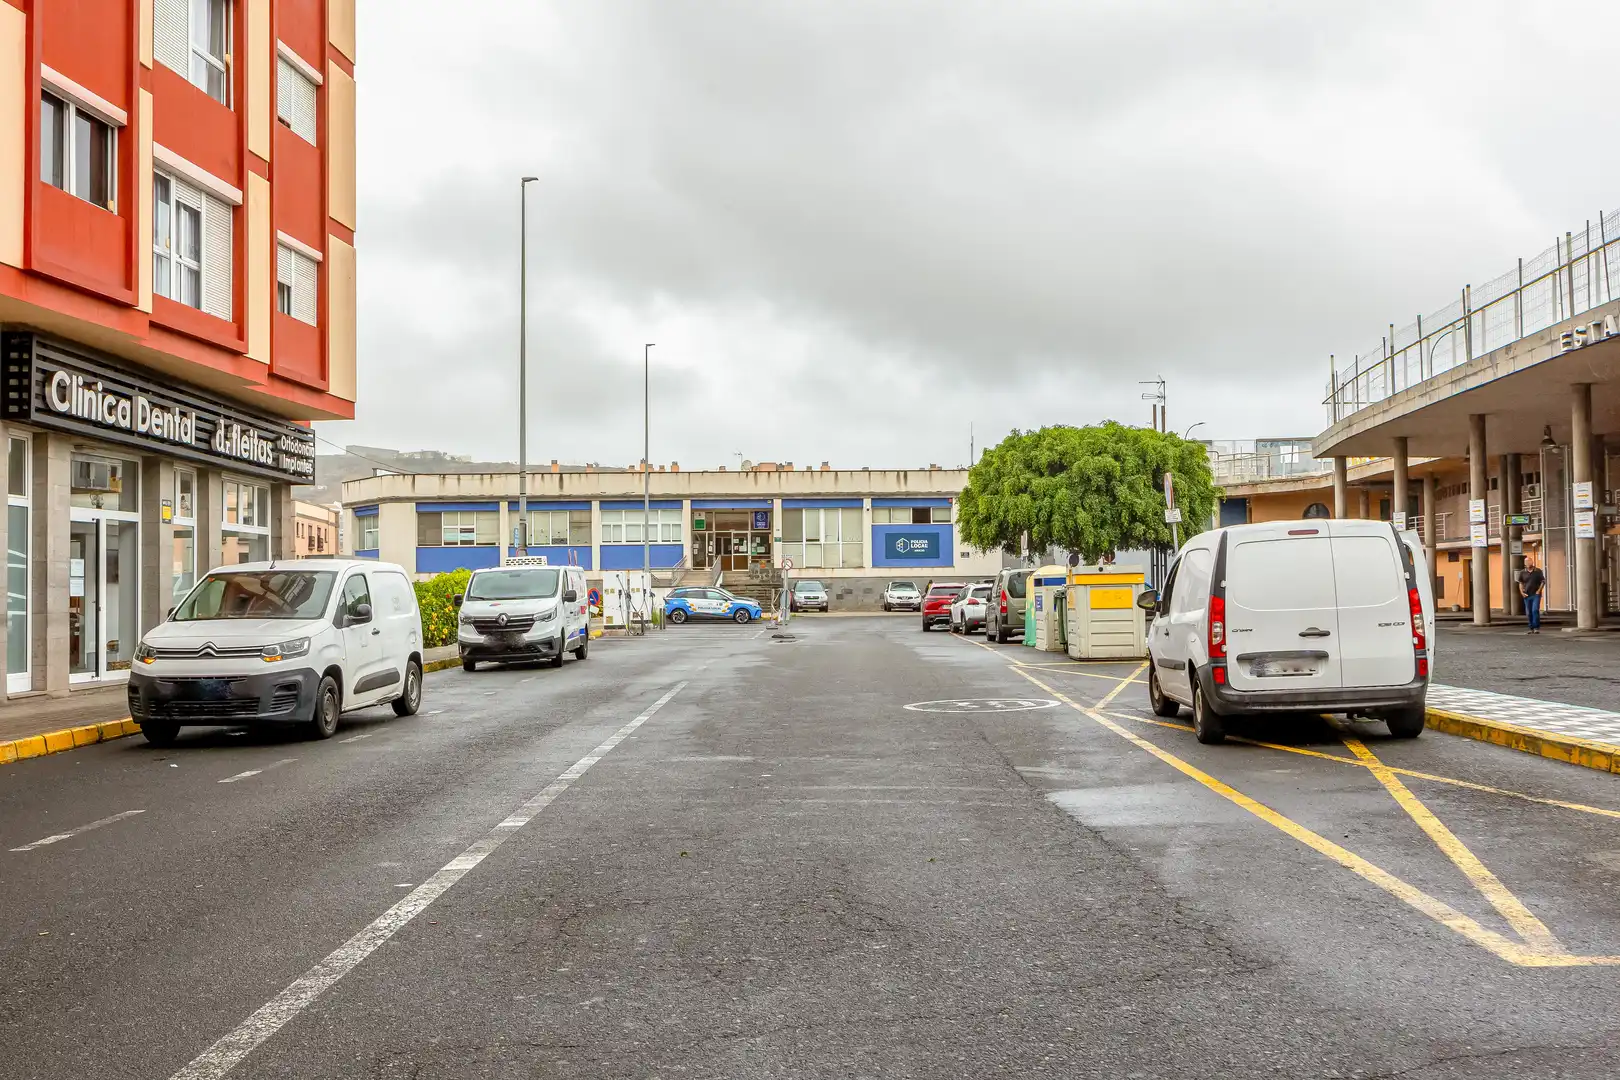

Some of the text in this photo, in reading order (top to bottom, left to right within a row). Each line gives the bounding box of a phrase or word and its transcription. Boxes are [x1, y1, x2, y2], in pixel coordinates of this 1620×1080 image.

[1559, 314, 1620, 352] ESTA
[51, 370, 196, 445] Clinica Dental
[232, 423, 273, 465] fleitas
[282, 453, 314, 474] Implantes
